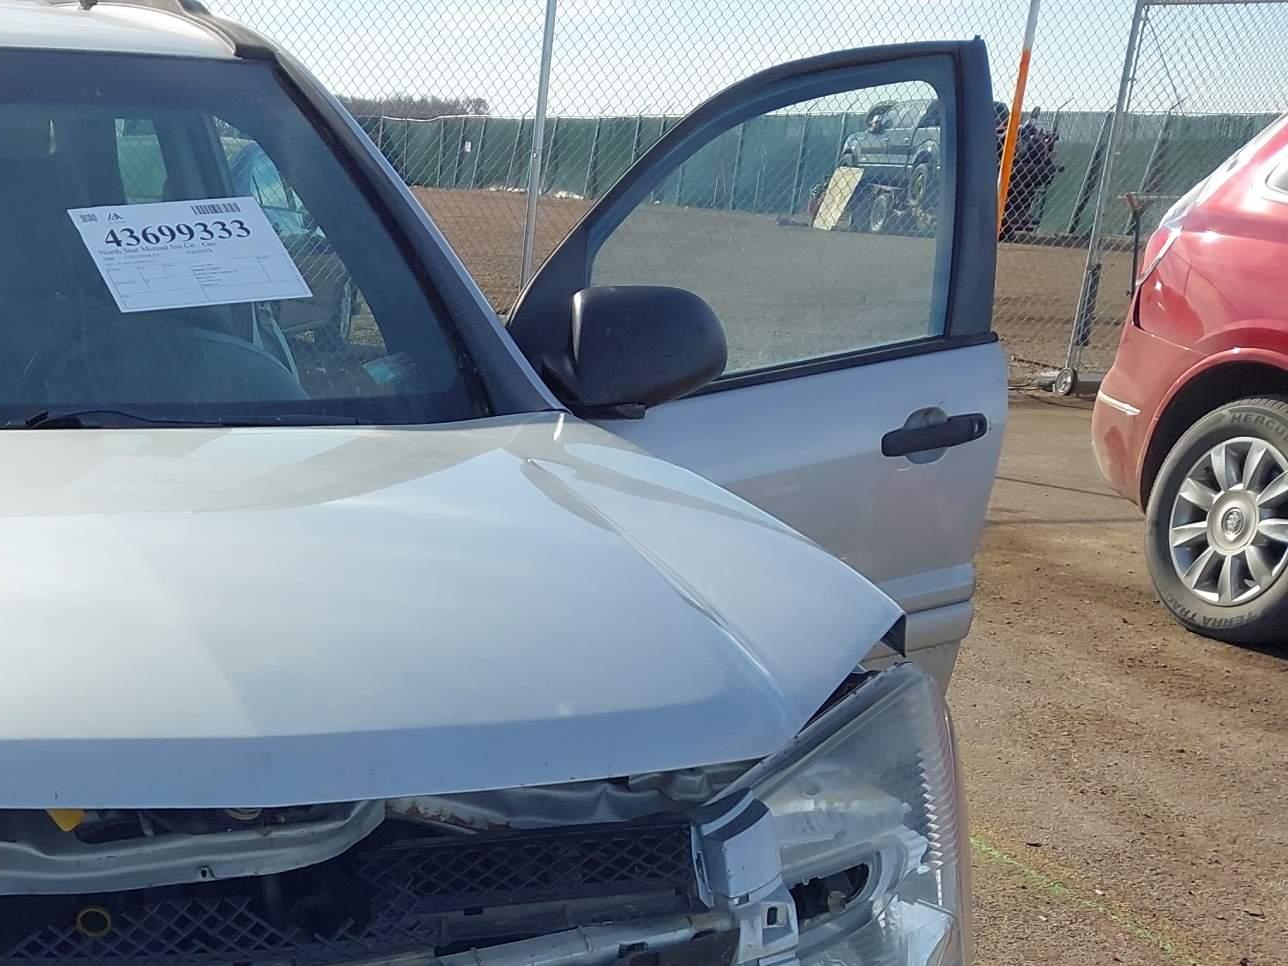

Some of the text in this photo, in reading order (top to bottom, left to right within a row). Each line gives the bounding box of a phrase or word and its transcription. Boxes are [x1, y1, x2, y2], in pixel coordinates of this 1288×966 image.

[105, 219, 251, 247] 43699333
[98, 248, 122, 256] North
[1165, 592, 1255, 627] TERRA TRAC
